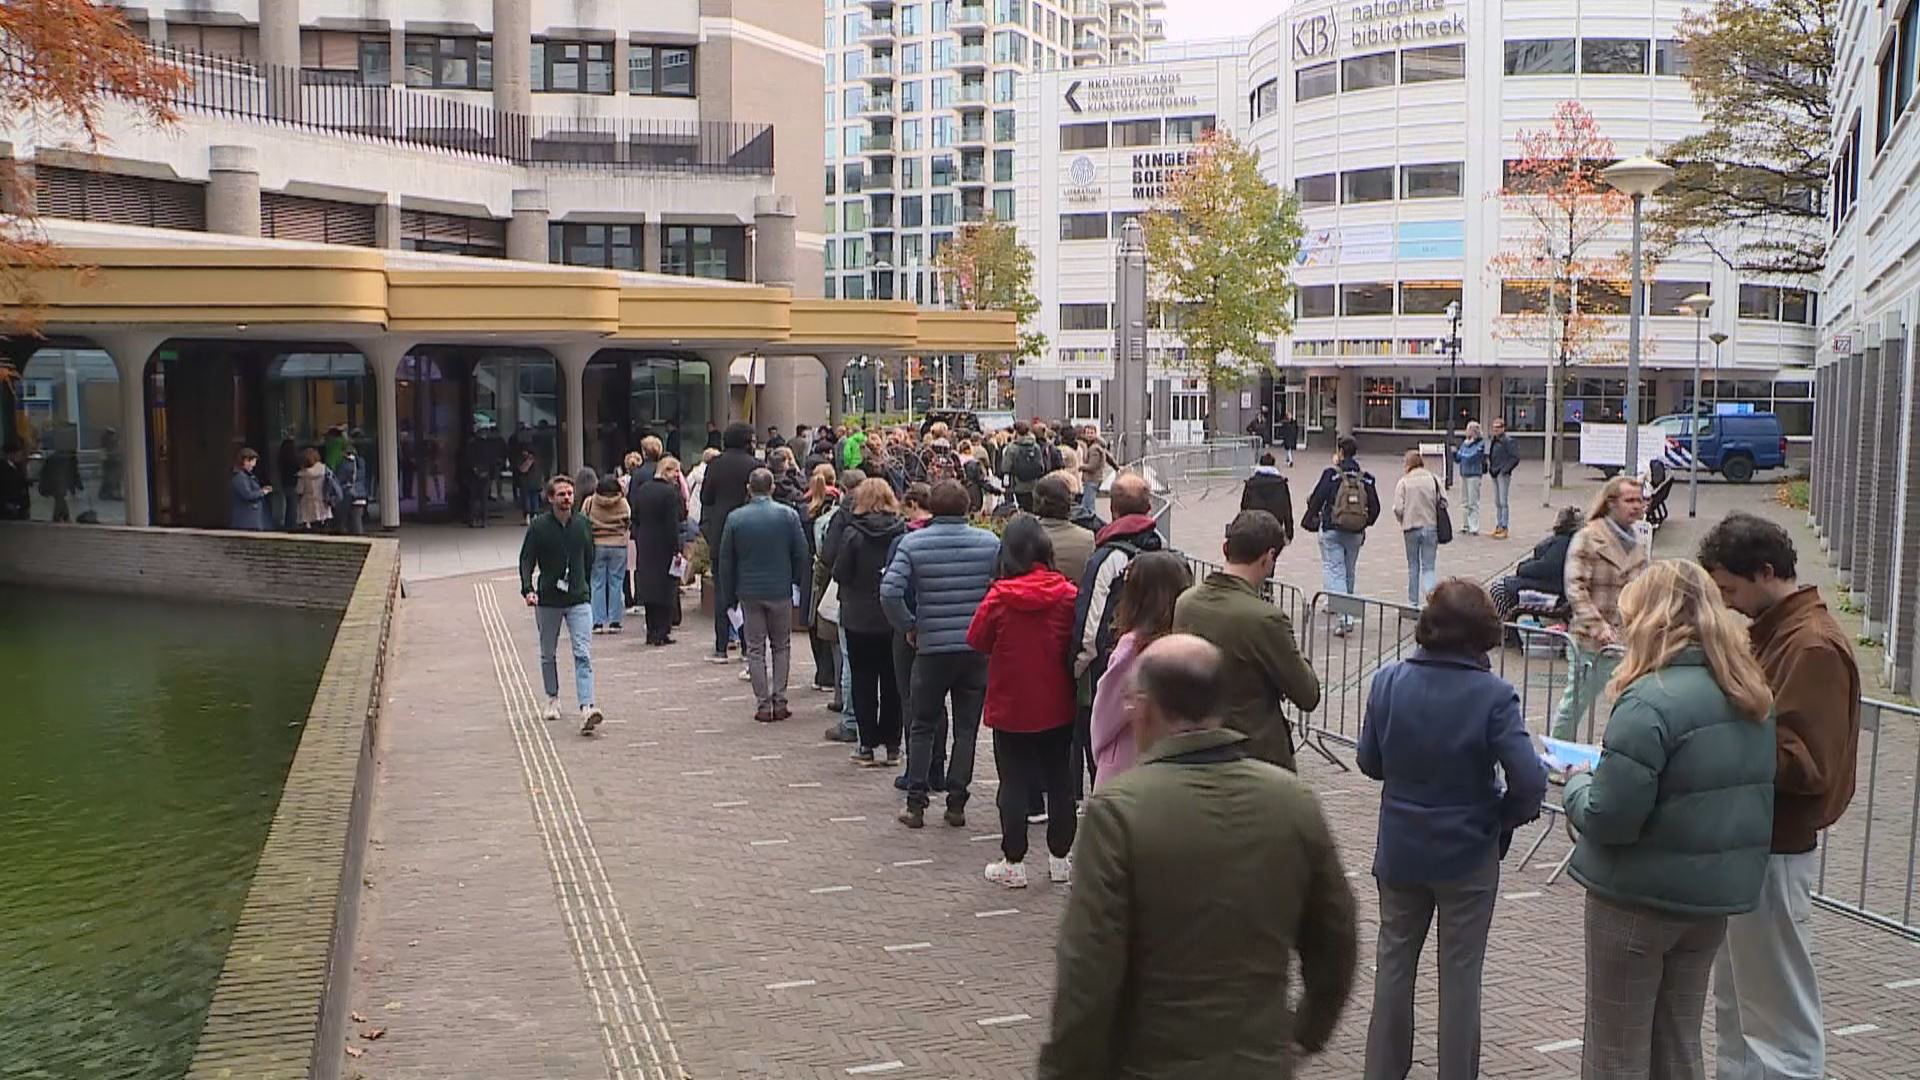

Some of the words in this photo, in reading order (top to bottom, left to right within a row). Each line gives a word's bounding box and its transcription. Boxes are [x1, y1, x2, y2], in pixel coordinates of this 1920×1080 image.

[1292, 15, 1329, 61] KB
[1352, 12, 1466, 47] bibliotheek
[1088, 79, 1110, 90] RKD
[1112, 73, 1182, 87] NEDERLANDS
[1088, 87, 1142, 101] INSTITUUT
[1145, 84, 1176, 97] VOOR
[1088, 95, 1198, 113] KUNSTGESCHIEDENIS
